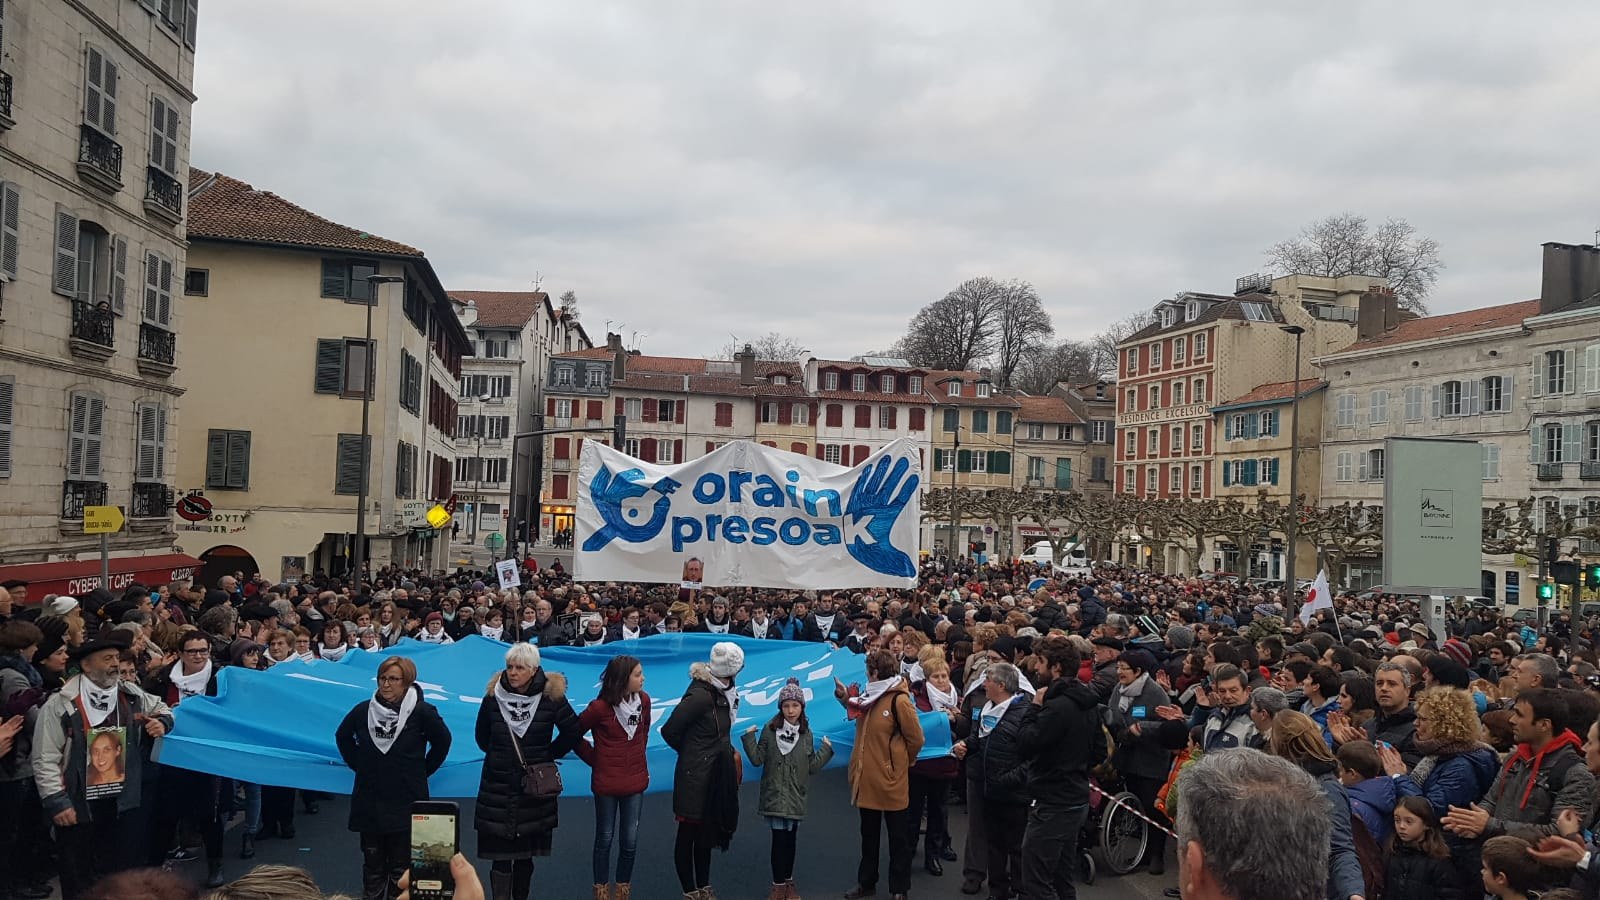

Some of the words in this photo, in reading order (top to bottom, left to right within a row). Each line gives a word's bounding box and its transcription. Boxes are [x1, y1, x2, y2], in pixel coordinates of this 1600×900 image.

[1166, 404, 1210, 419] EXCELSIOR
[692, 469, 843, 518] orain
[207, 514, 247, 522] GOYTY
[68, 576, 113, 595] CYBERNT
